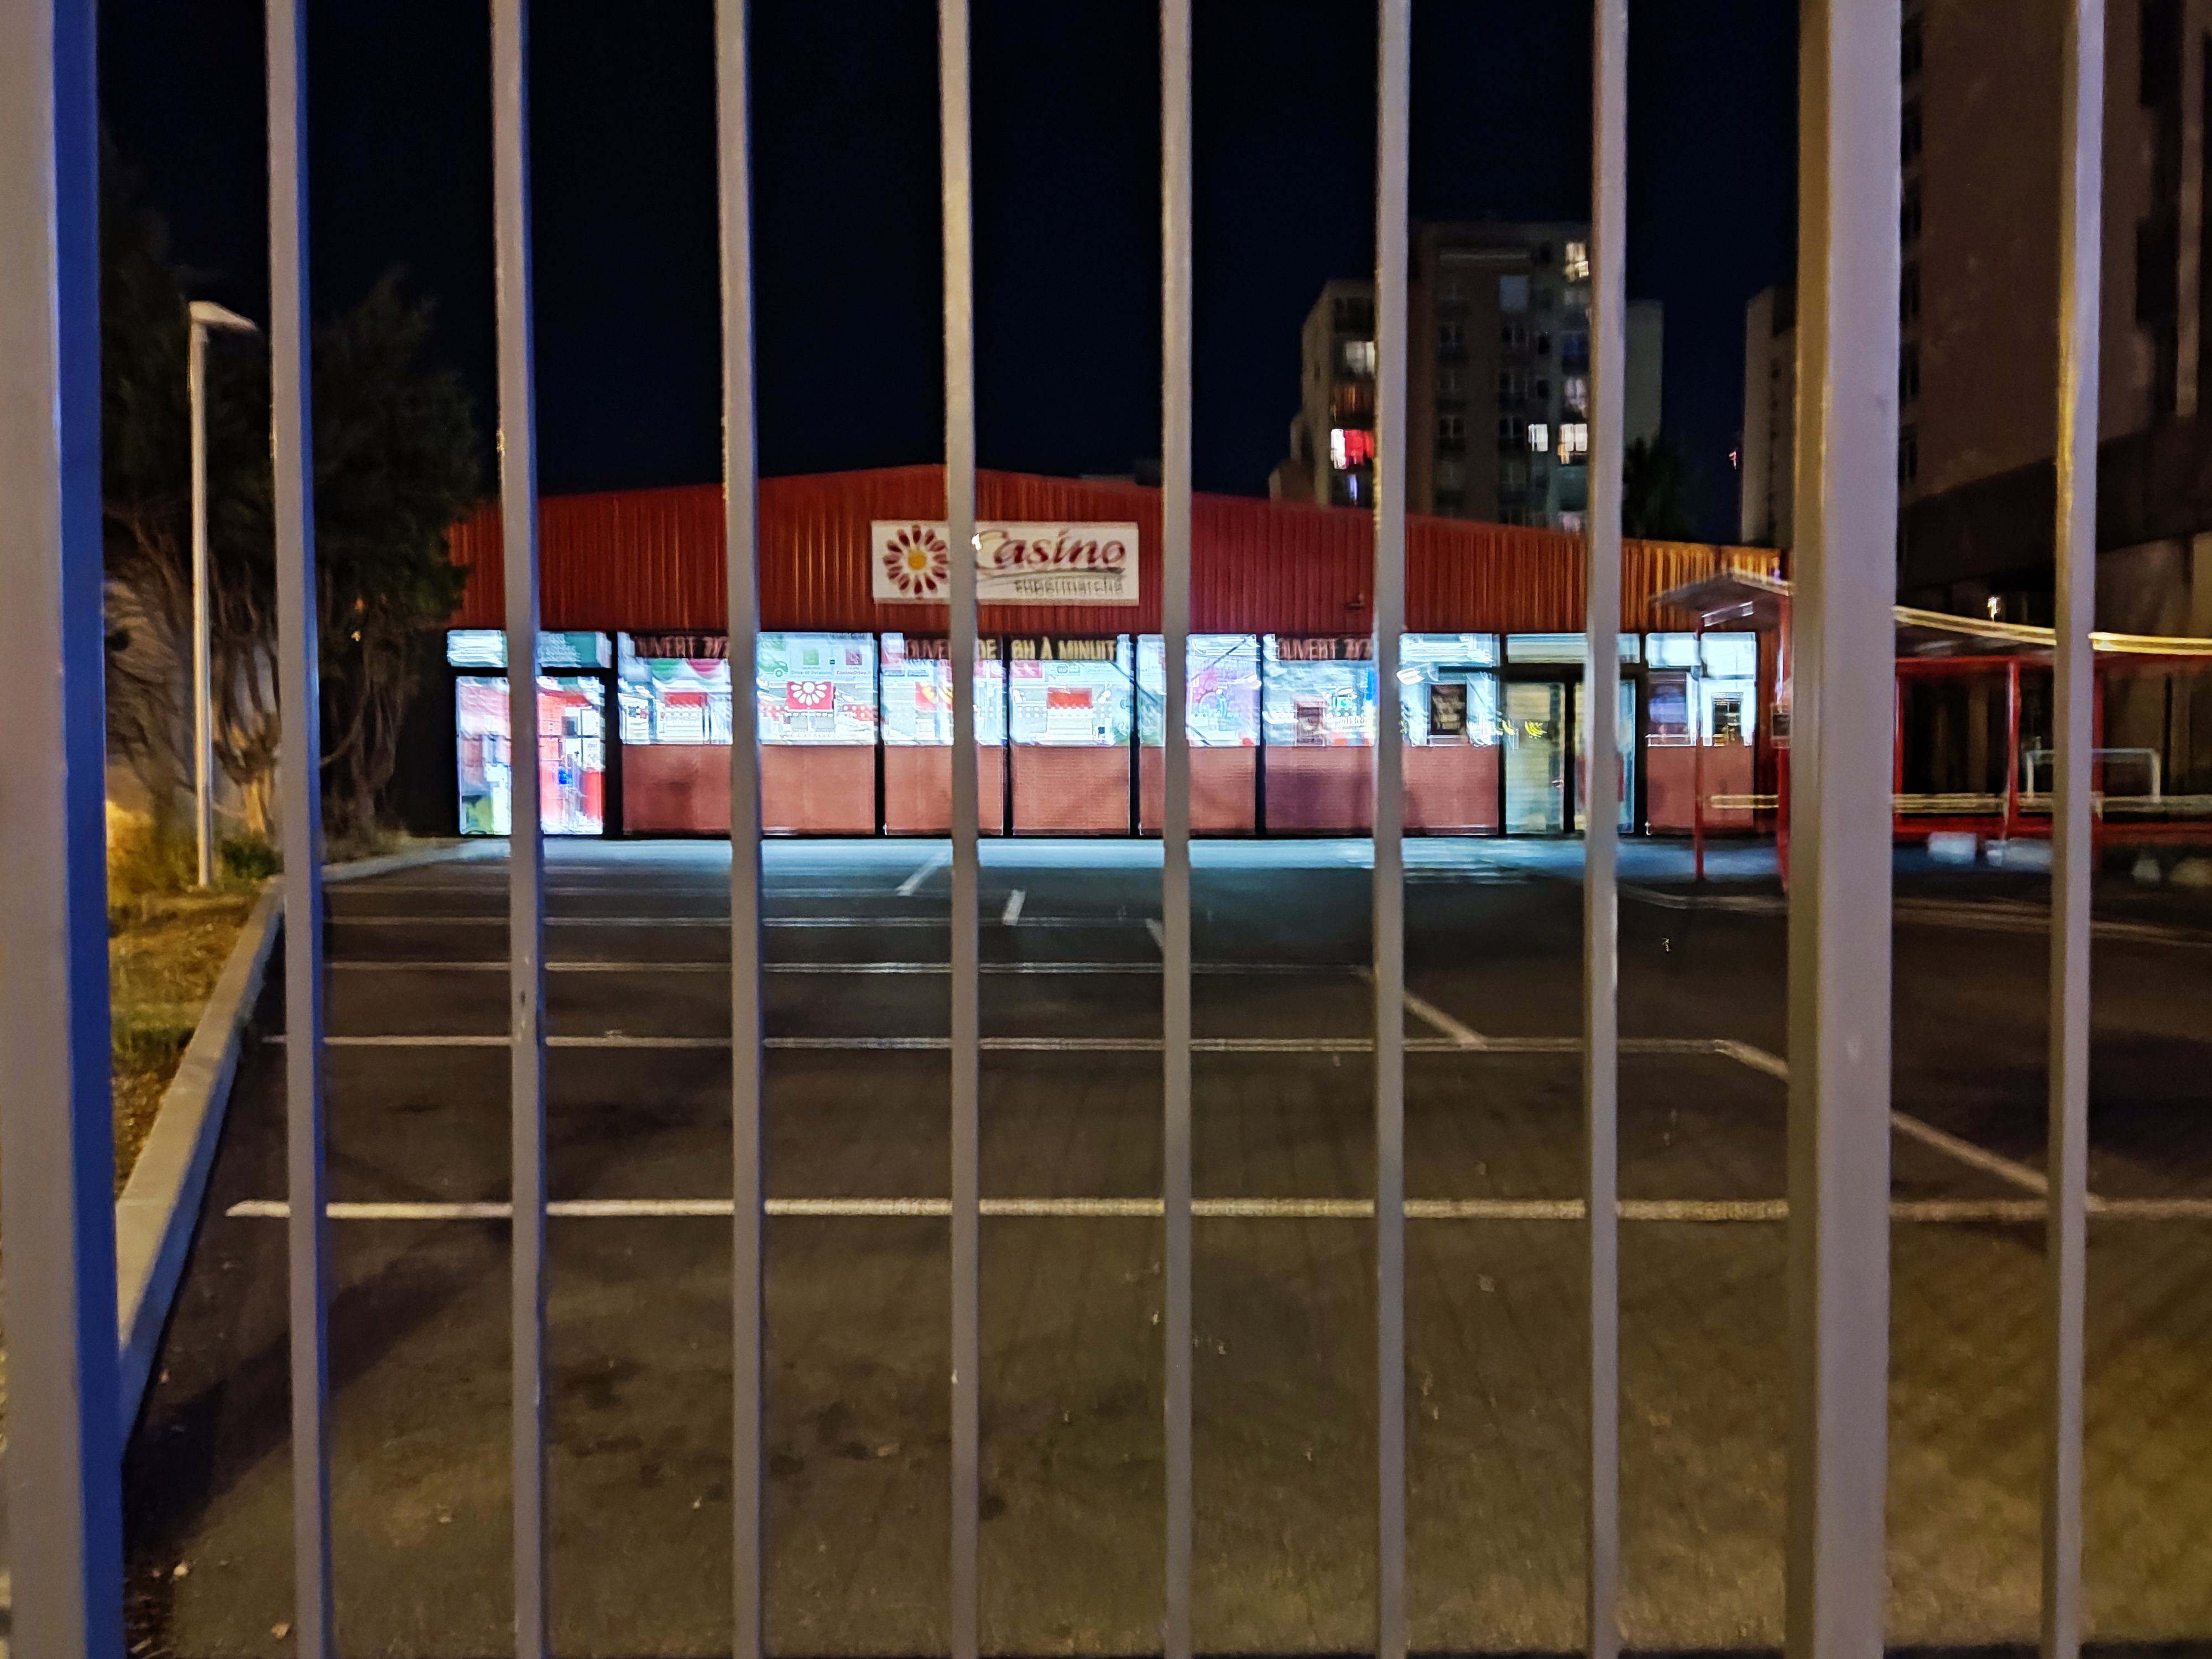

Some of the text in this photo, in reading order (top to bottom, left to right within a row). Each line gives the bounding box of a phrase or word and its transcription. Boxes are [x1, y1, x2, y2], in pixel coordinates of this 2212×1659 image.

[972, 529, 1126, 570] Casino
[1058, 640, 1116, 660] MINUIT
[1277, 638, 1338, 659] OUVERT
